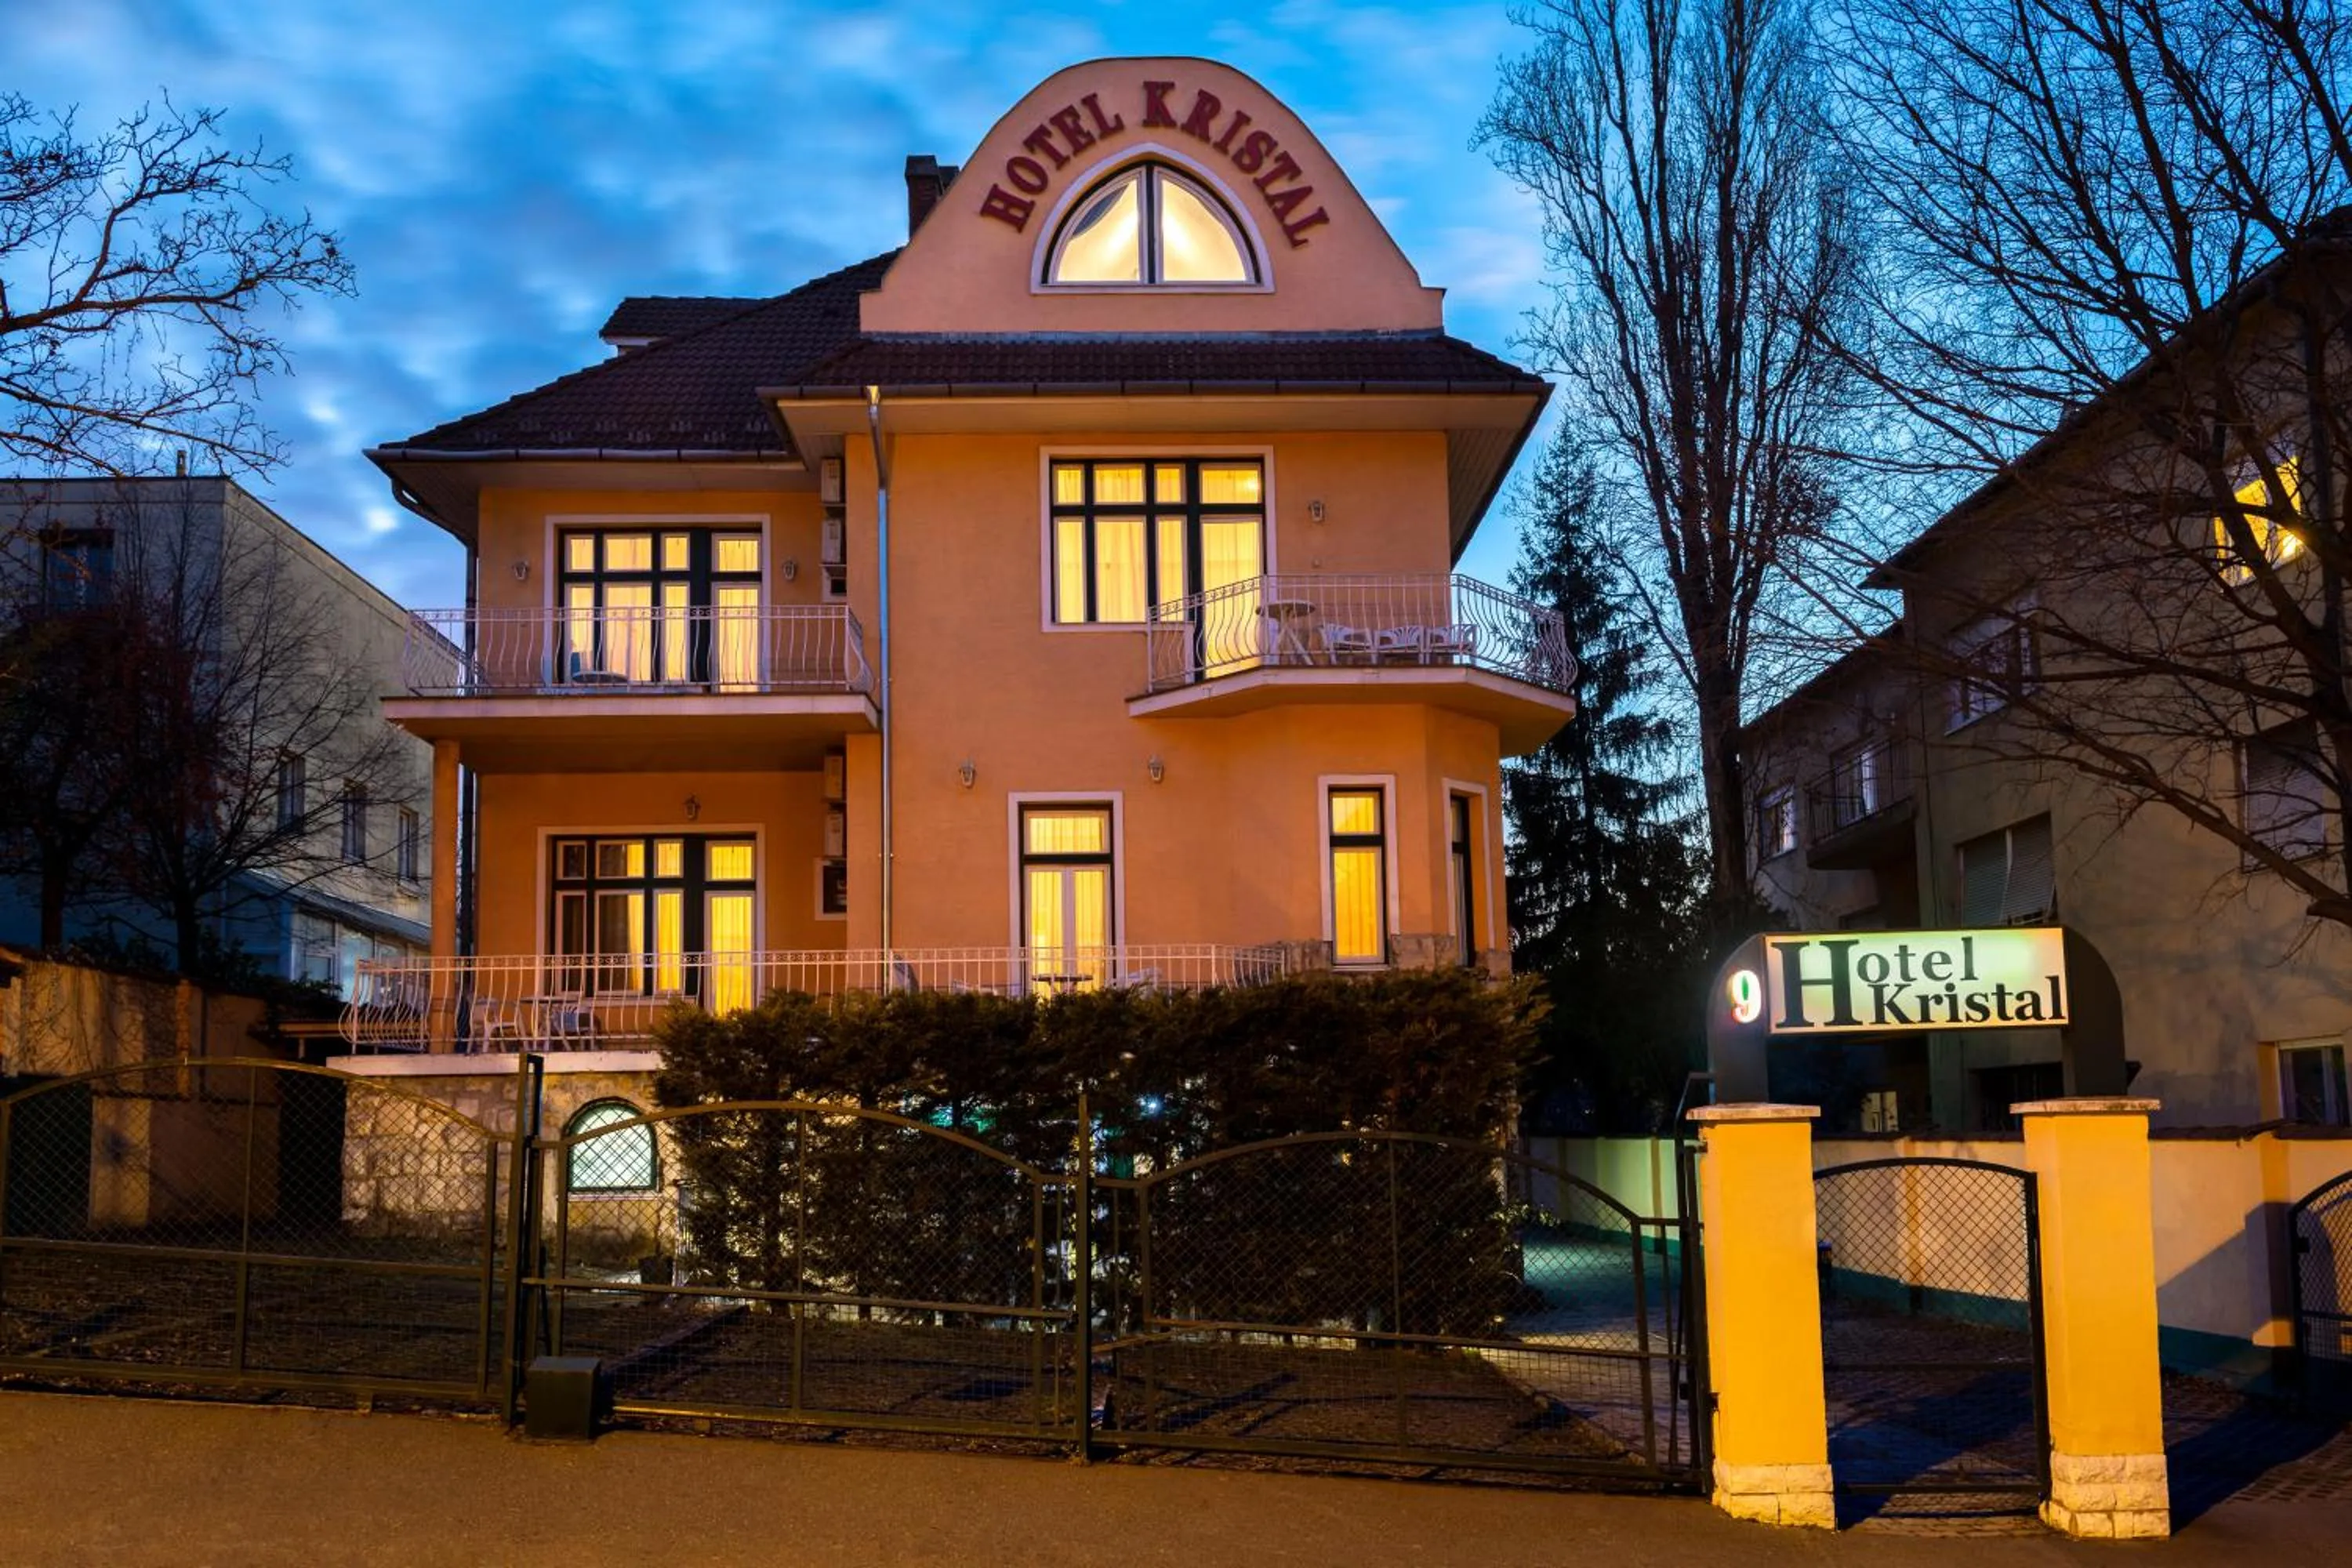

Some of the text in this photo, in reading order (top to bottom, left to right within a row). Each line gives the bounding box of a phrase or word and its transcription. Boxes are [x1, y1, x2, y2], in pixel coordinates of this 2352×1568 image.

[978, 81, 1330, 249] HOTEL KRISTAL
[1730, 969, 1762, 1023] 9
[1771, 936, 1980, 1029] Hotel
[1867, 975, 2067, 1025] Kristal
